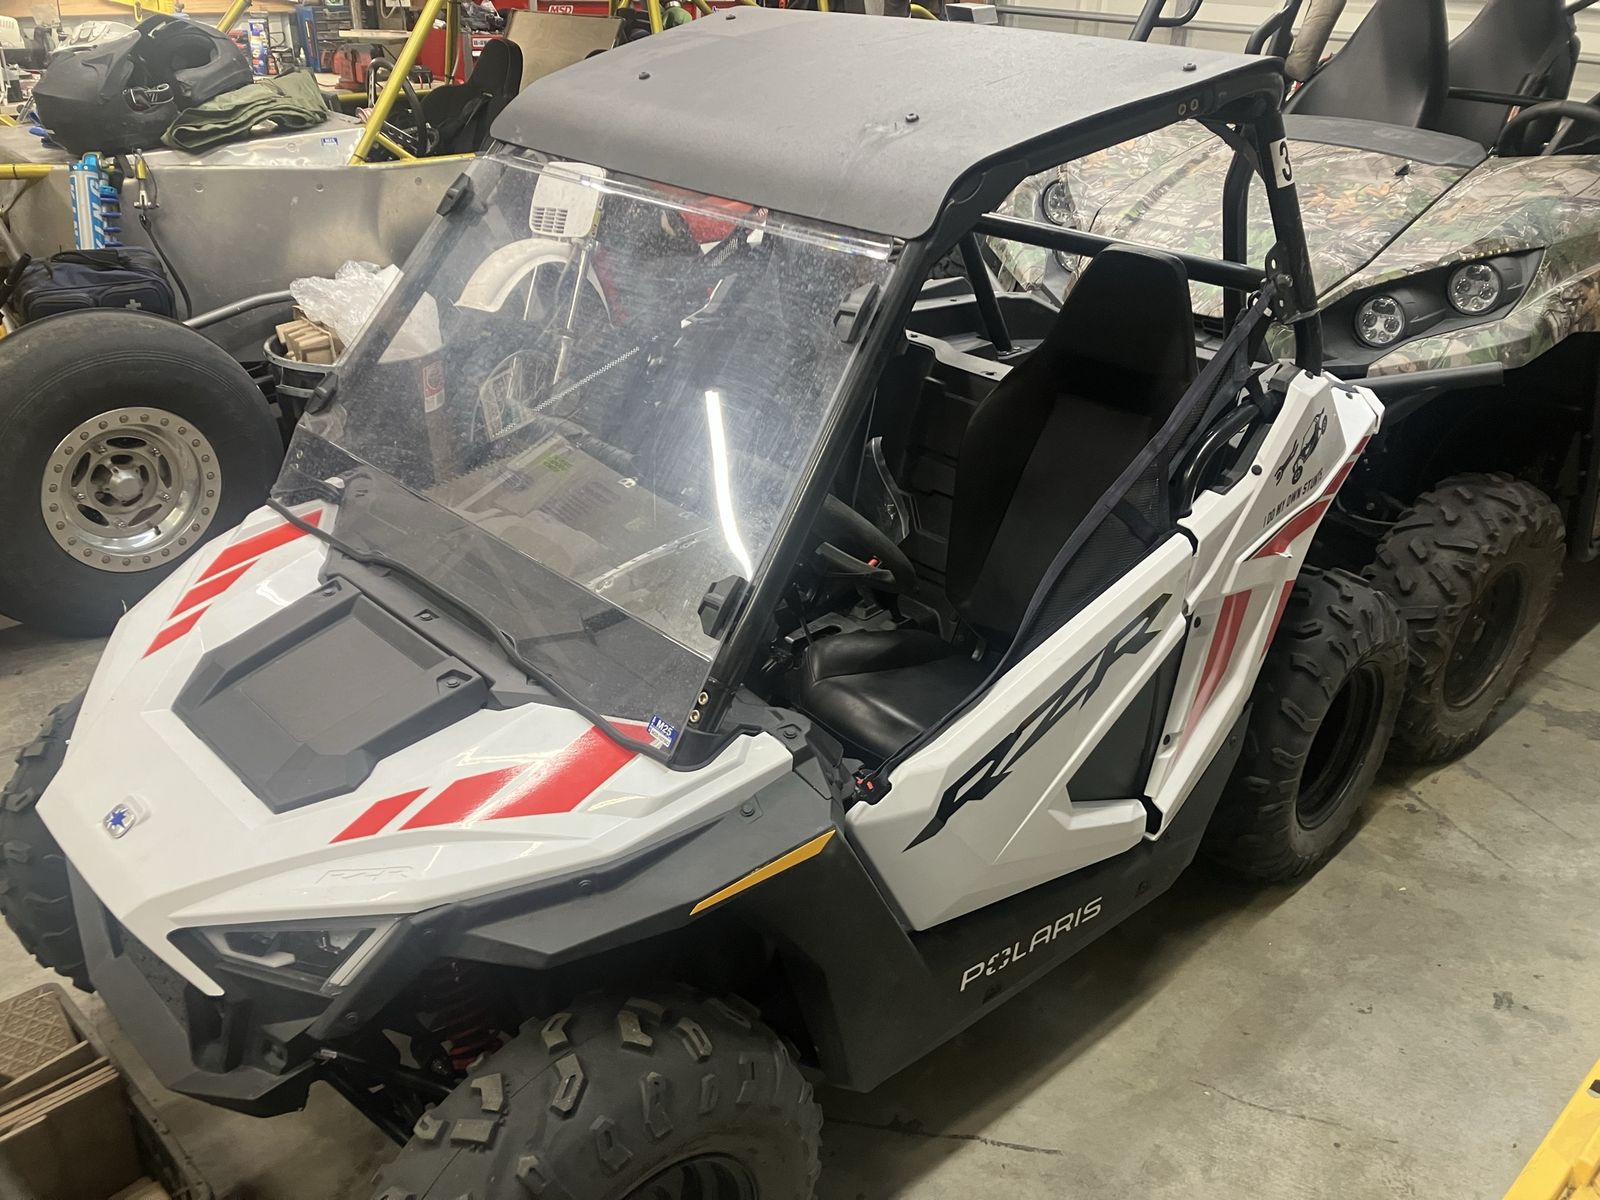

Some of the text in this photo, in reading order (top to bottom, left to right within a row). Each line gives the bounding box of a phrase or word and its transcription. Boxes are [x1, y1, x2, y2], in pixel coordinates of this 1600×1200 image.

[549, 5, 573, 14] MSD
[1280, 141, 1292, 181] 3
[1263, 516, 1267, 528] I
[1266, 508, 1275, 525] DO
[1276, 498, 1286, 516] MY
[1287, 487, 1302, 507] OWN
[656, 719, 674, 737] M25
[902, 593, 1162, 853] RZR
[960, 896, 1103, 992] POLARIS
